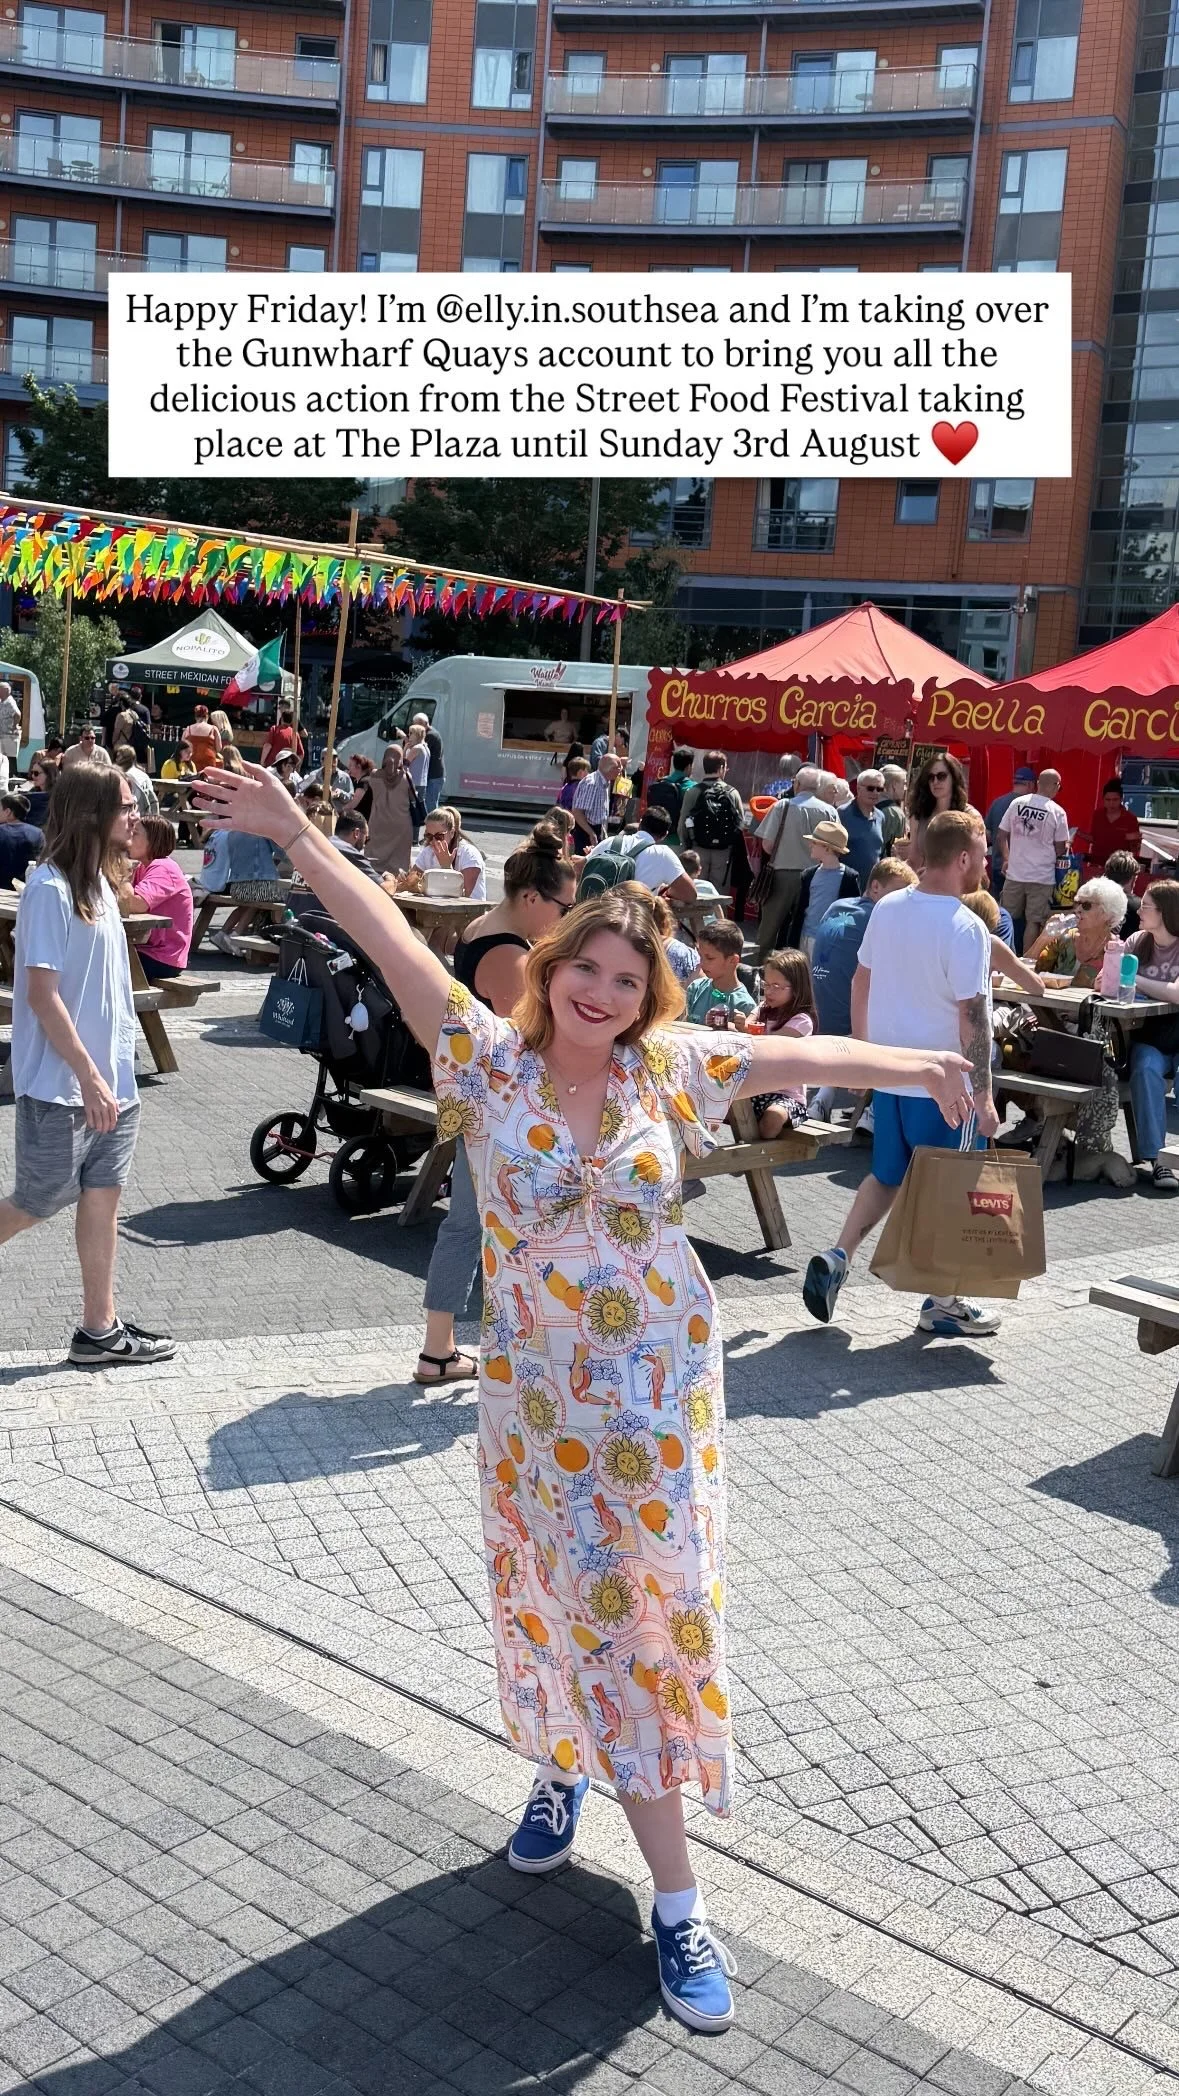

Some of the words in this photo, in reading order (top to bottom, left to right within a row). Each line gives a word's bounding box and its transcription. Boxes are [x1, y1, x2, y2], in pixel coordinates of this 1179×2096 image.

[176, 645, 225, 655] NOPALITO
[144, 669, 178, 680] STREET
[180, 671, 219, 684] MEXICAN
[530, 666, 560, 681] Waffle
[661, 679, 767, 724] Churros
[779, 685, 877, 729] Garcia
[927, 690, 1046, 735] Paella
[1083, 699, 1179, 742] Garci
[1017, 805, 1048, 821] VANS
